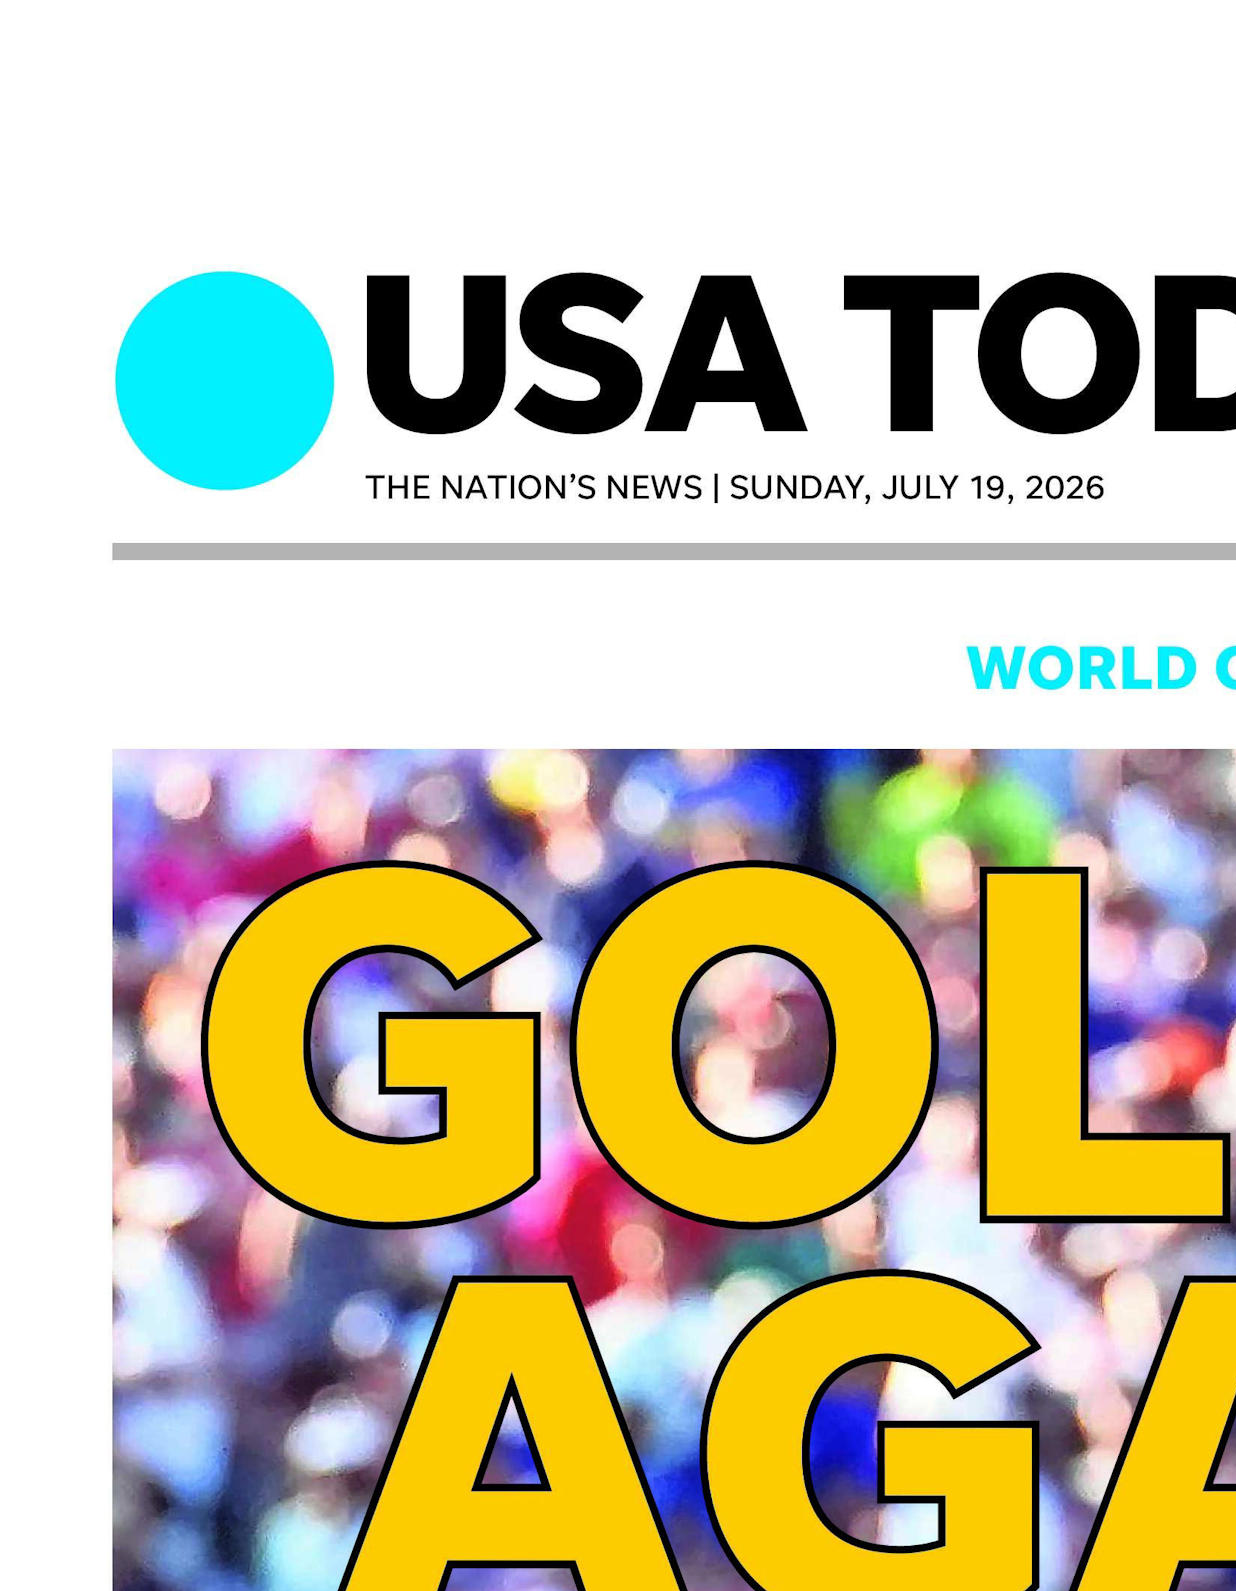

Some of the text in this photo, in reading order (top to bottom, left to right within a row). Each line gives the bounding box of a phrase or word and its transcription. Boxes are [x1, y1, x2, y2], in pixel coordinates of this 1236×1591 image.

[367, 272, 808, 434] USA
[366, 474, 1104, 504] THE NATION’S NEWS SUNDAY, JULY 19, 2026
[967, 646, 1196, 690] WORLD
